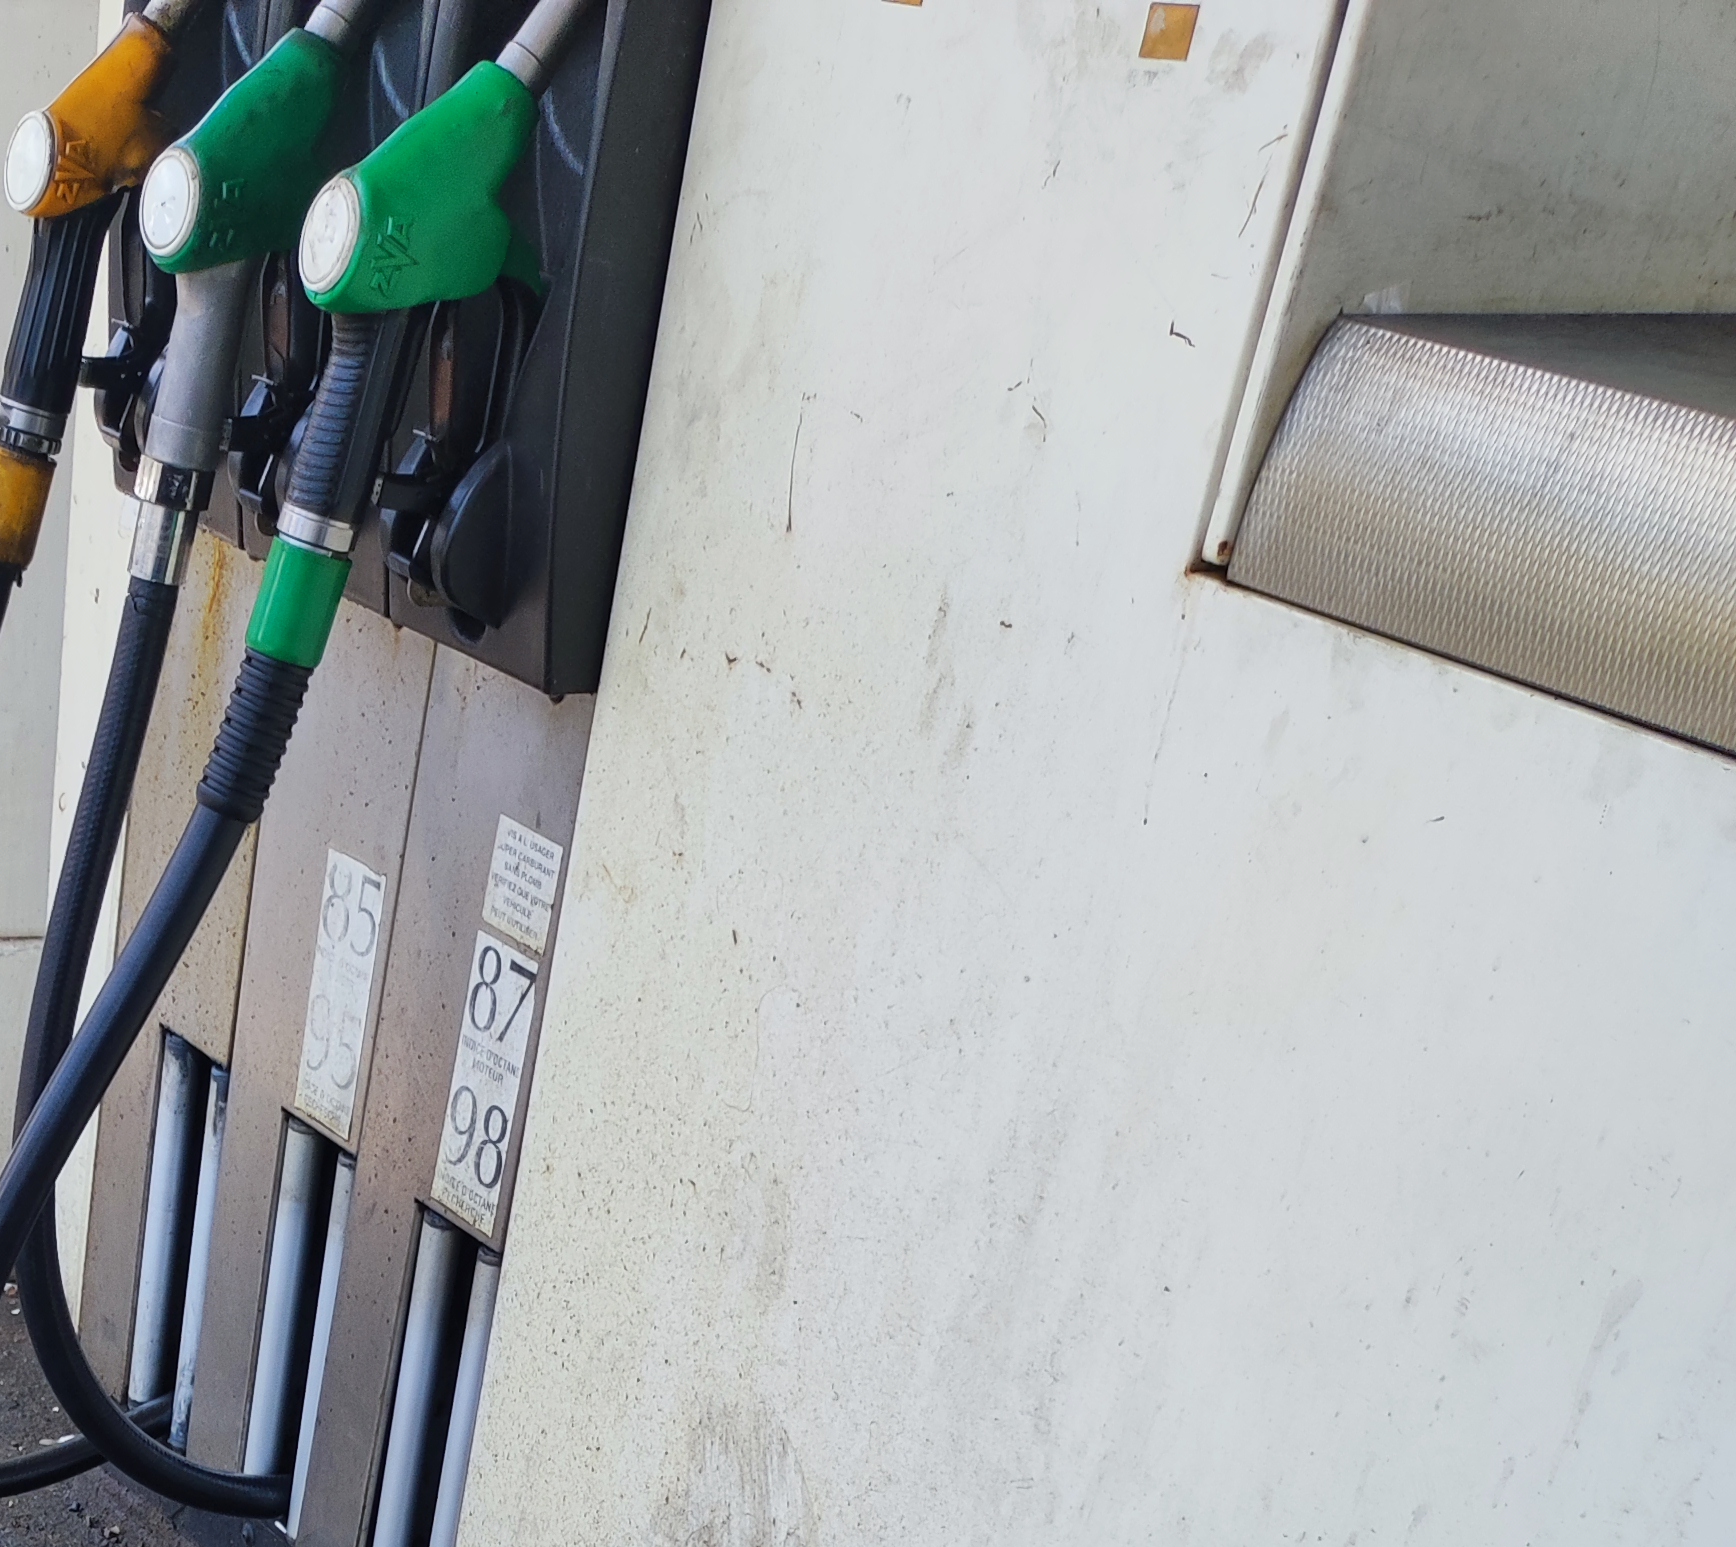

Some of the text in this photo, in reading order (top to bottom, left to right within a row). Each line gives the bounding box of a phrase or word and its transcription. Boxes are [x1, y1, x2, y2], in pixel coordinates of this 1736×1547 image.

[322, 862, 381, 957] 85
[468, 945, 537, 1042] 87
[306, 994, 362, 1090] 95
[471, 1057, 504, 1085] MOTEUR
[445, 1085, 508, 1189] 98
